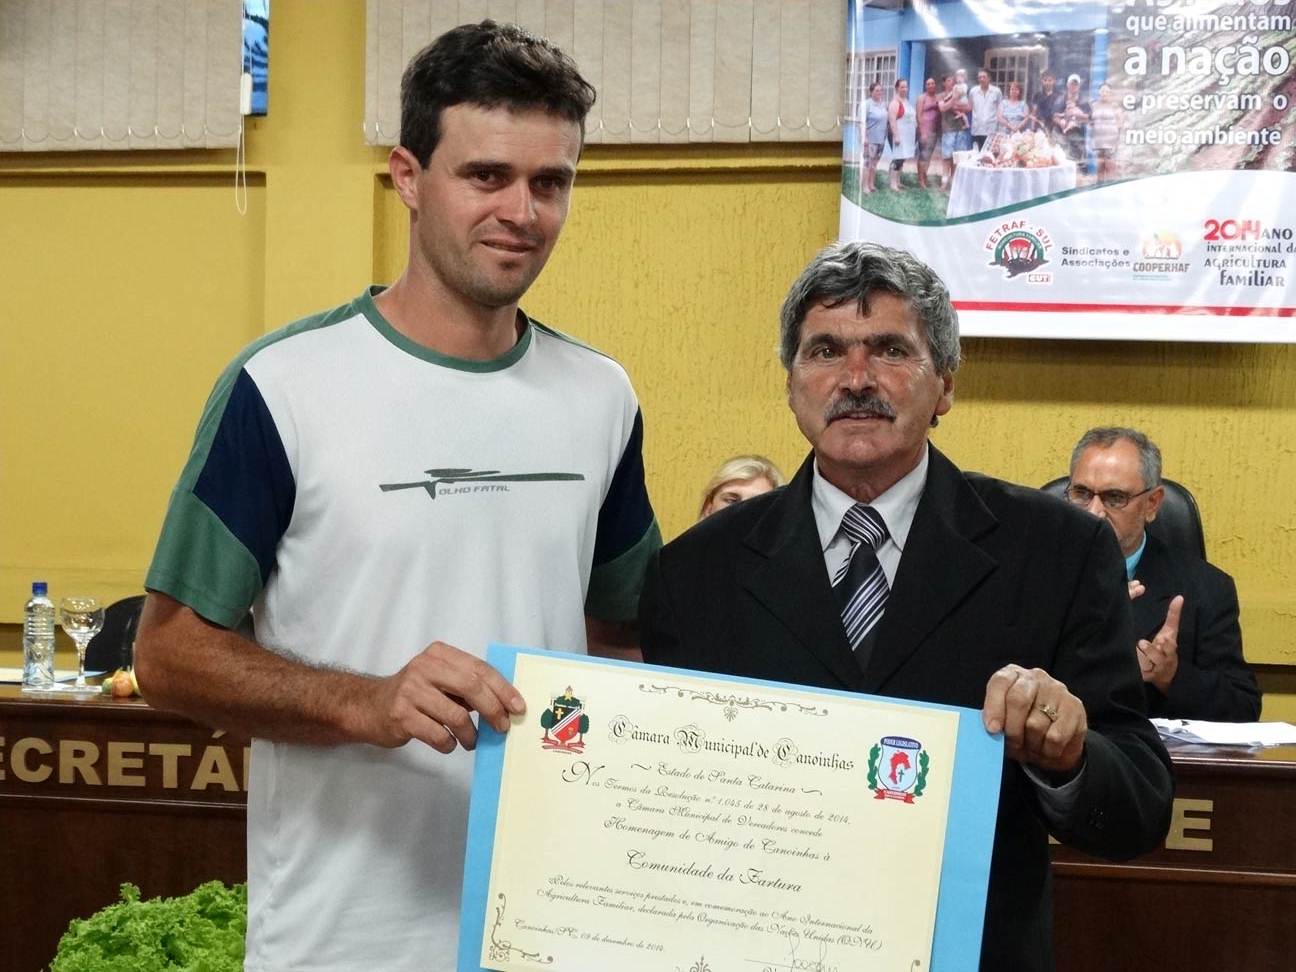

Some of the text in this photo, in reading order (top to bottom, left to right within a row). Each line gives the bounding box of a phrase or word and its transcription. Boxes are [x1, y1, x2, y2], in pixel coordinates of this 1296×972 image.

[1125, 12, 1292, 36] que alimentam
[1124, 36, 1290, 86] a nação
[1122, 93, 1288, 115] e preservam o
[1125, 125, 1281, 146] meio ambiente
[1203, 219, 1293, 241] 2014 ANO
[1061, 246, 1120, 256] Sindicatos
[1061, 258, 1131, 269] Associações
[1132, 262, 1191, 273] COOPERHAF
[474, 485, 511, 493] FATAL
[608, 714, 670, 745] Câmara
[674, 723, 755, 759] Municipal
[772, 737, 854, 772] Canoinhas
[657, 761, 796, 794] Estado de Santa Catarina
[604, 777, 637, 793] Termos
[640, 785, 651, 795] da
[654, 785, 701, 803] Resolução
[744, 800, 754, 810] de
[757, 802, 768, 812] 28
[771, 803, 782, 814] de
[785, 807, 811, 820] agosto
[814, 809, 824, 820] de
[627, 797, 665, 815] Câmara
[669, 806, 719, 823] Municipal
[722, 814, 732, 824] de
[737, 814, 788, 833] Vereadores
[790, 826, 823, 838] concede
[603, 816, 675, 840] Homenagem
[678, 828, 691, 841] de
[695, 830, 739, 852] Amigo
[743, 838, 755, 850] de
[761, 838, 819, 860] Canoinhas
[626, 849, 802, 893] Comunidade da Fartura
